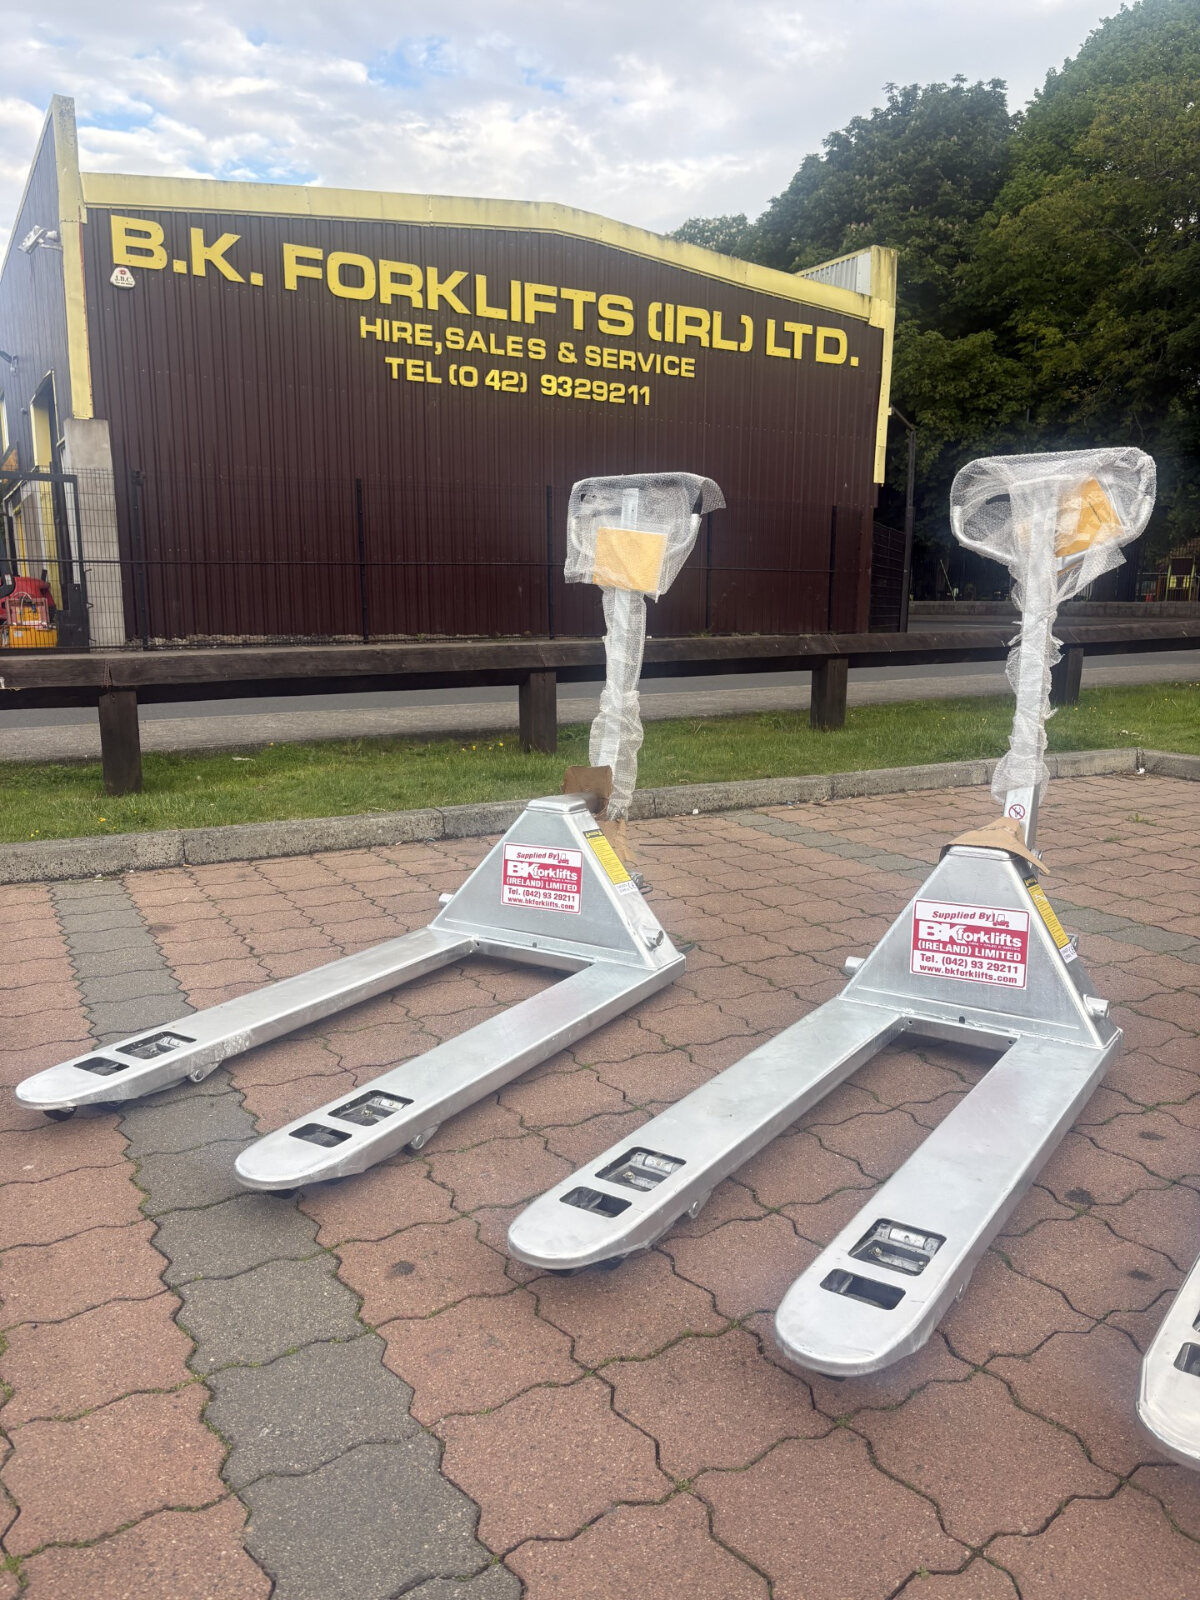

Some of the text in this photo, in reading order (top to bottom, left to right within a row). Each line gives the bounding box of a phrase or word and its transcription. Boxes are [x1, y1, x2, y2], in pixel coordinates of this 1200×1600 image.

[110, 215, 859, 367] B.K. FORKLIFTS (IRL) LTD.
[558, 342, 578, 364] &
[585, 345, 696, 378] SERVICE
[385, 357, 442, 384] TEL
[540, 374, 650, 406] 9329211
[516, 852, 546, 860] Supplied
[506, 877, 543, 888] (IRELAND)
[546, 881, 577, 891] LIMITED
[508, 897, 574, 910] www.bkforklifts.com
[523, 889, 540, 898] (042)
[554, 893, 575, 902] 29211
[932, 910, 991, 922] Supplied By
[918, 940, 972, 956] (IRELAND)
[975, 947, 1022, 961] LIMITED
[920, 953, 1018, 974] Tel. (042) 93 29211
[920, 964, 1017, 984] www.bkforklifts.com
